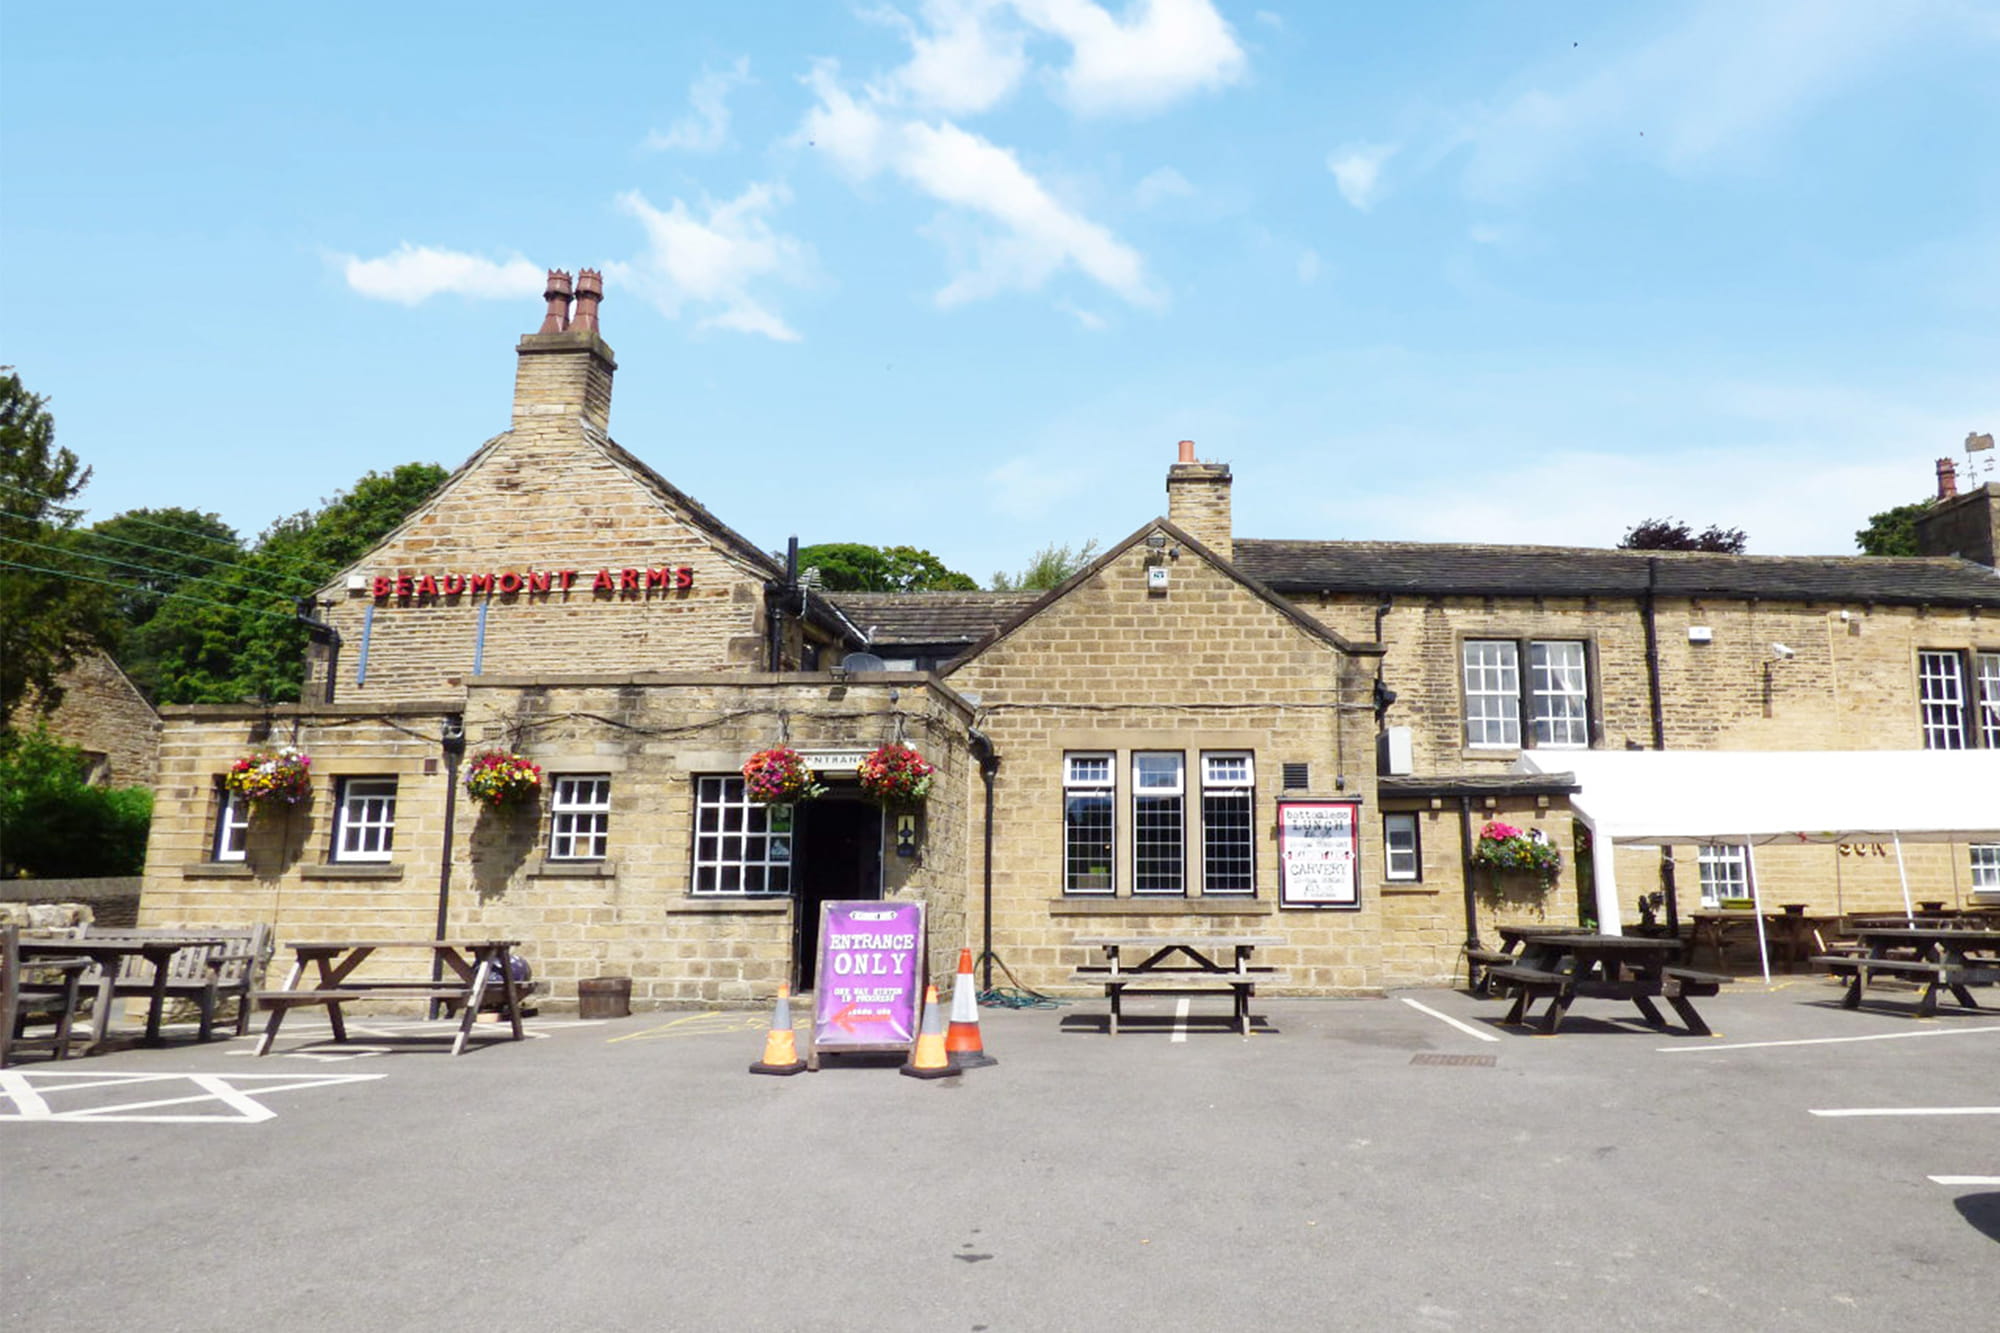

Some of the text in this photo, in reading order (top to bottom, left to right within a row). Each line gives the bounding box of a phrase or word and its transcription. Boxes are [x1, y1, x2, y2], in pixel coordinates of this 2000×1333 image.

[372, 567, 694, 597] BEAUMONT ARMS
[1292, 820, 1344, 831] LUNCH
[1290, 863, 1346, 876] CARVERY
[829, 933, 915, 950] ENTRANCE
[834, 952, 907, 975] ONLY
